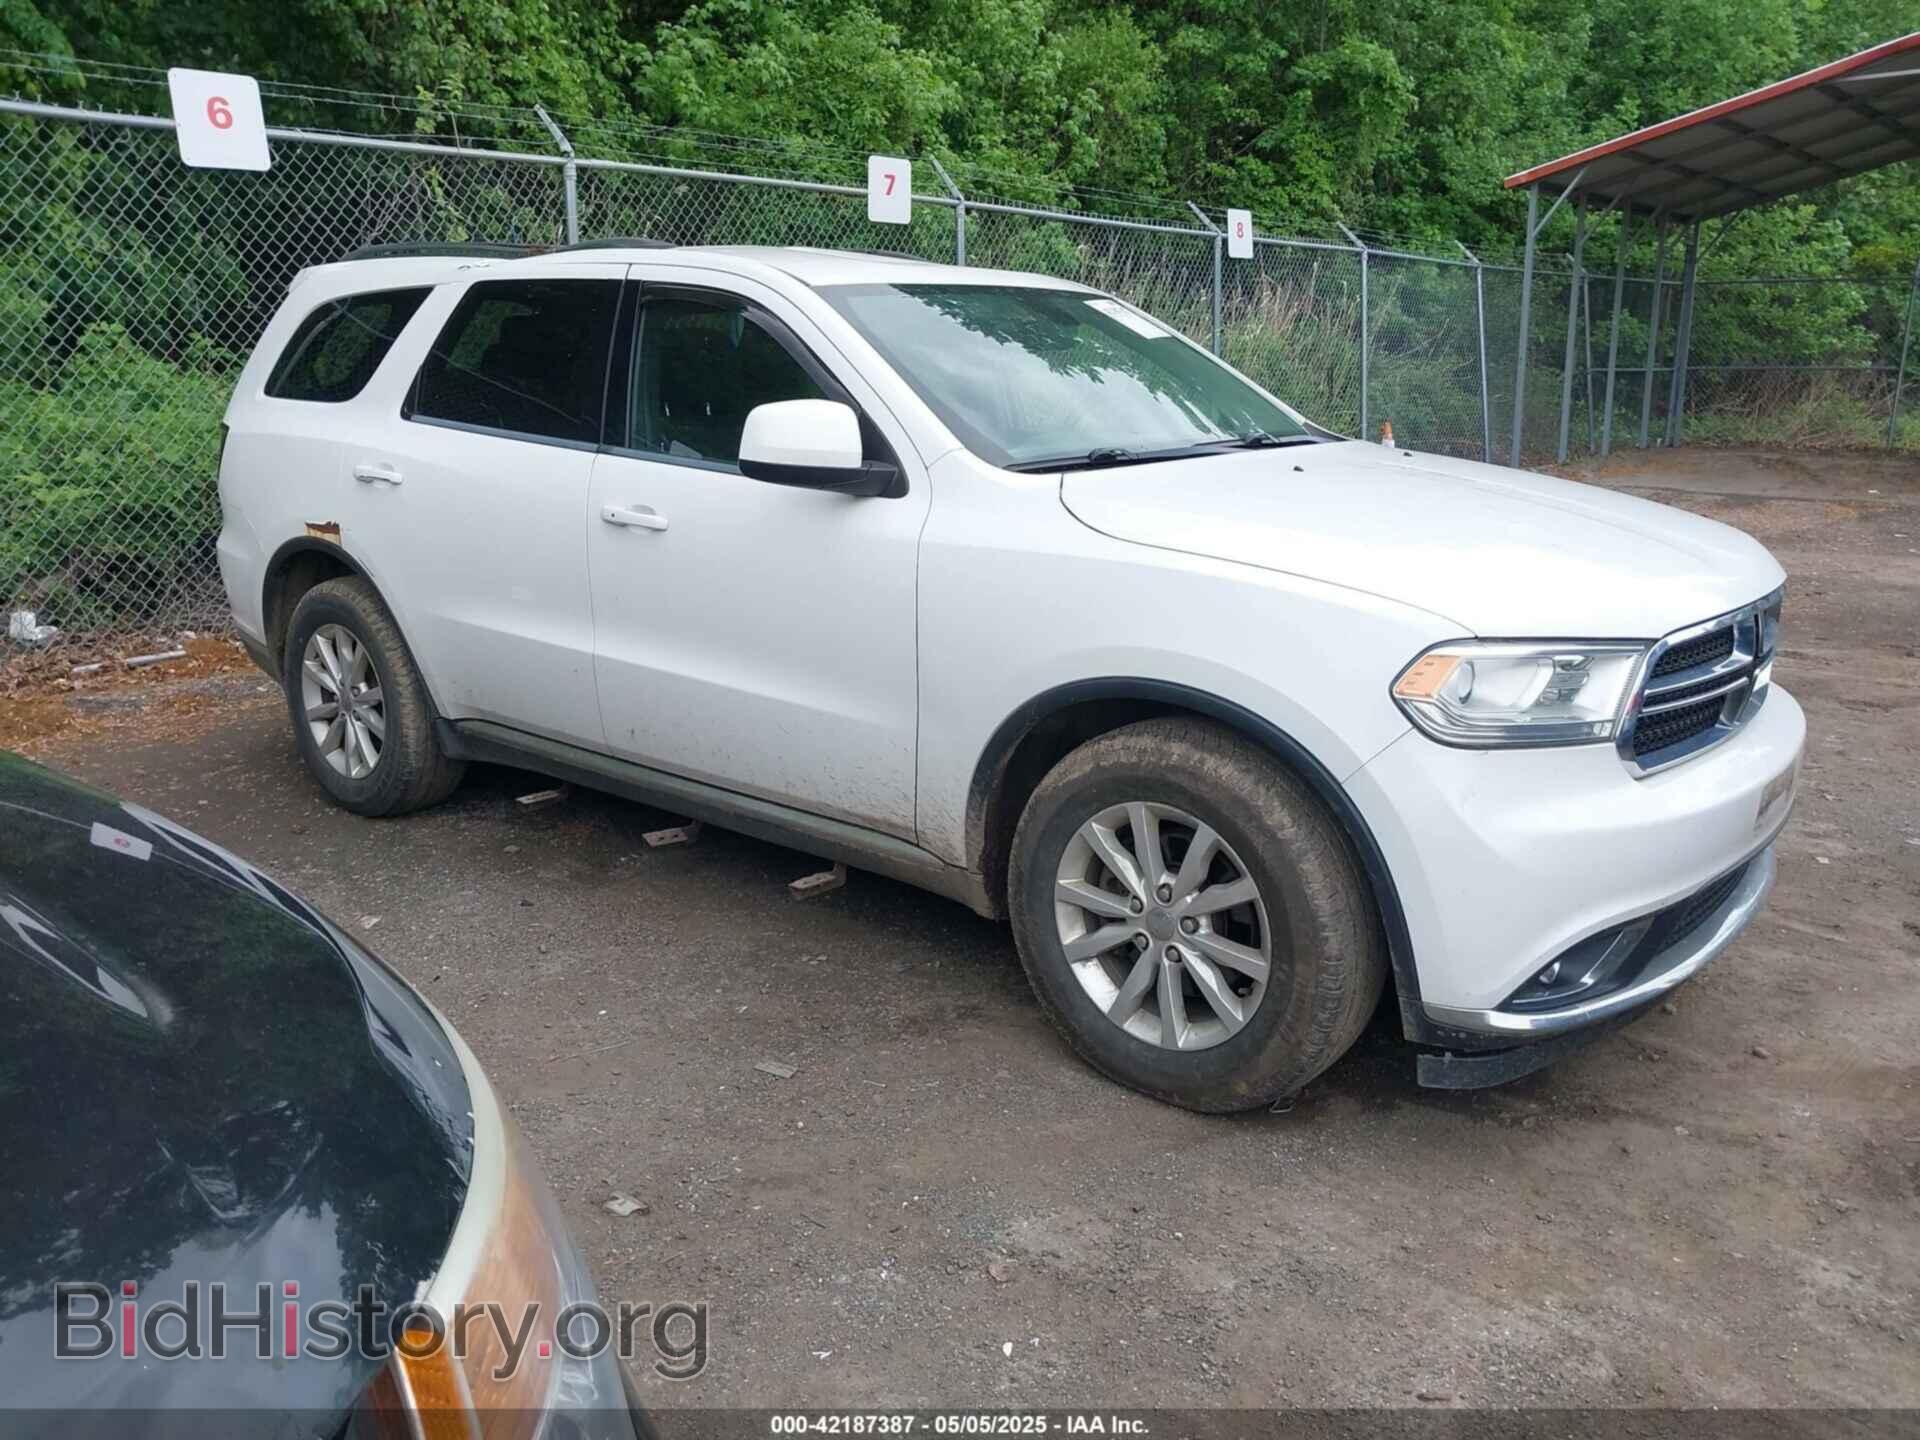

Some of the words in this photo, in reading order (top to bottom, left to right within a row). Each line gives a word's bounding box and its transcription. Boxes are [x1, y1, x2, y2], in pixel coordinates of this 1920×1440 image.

[206, 96, 233, 130] 6
[883, 174, 896, 196] 7
[1236, 222, 1245, 239] 8
